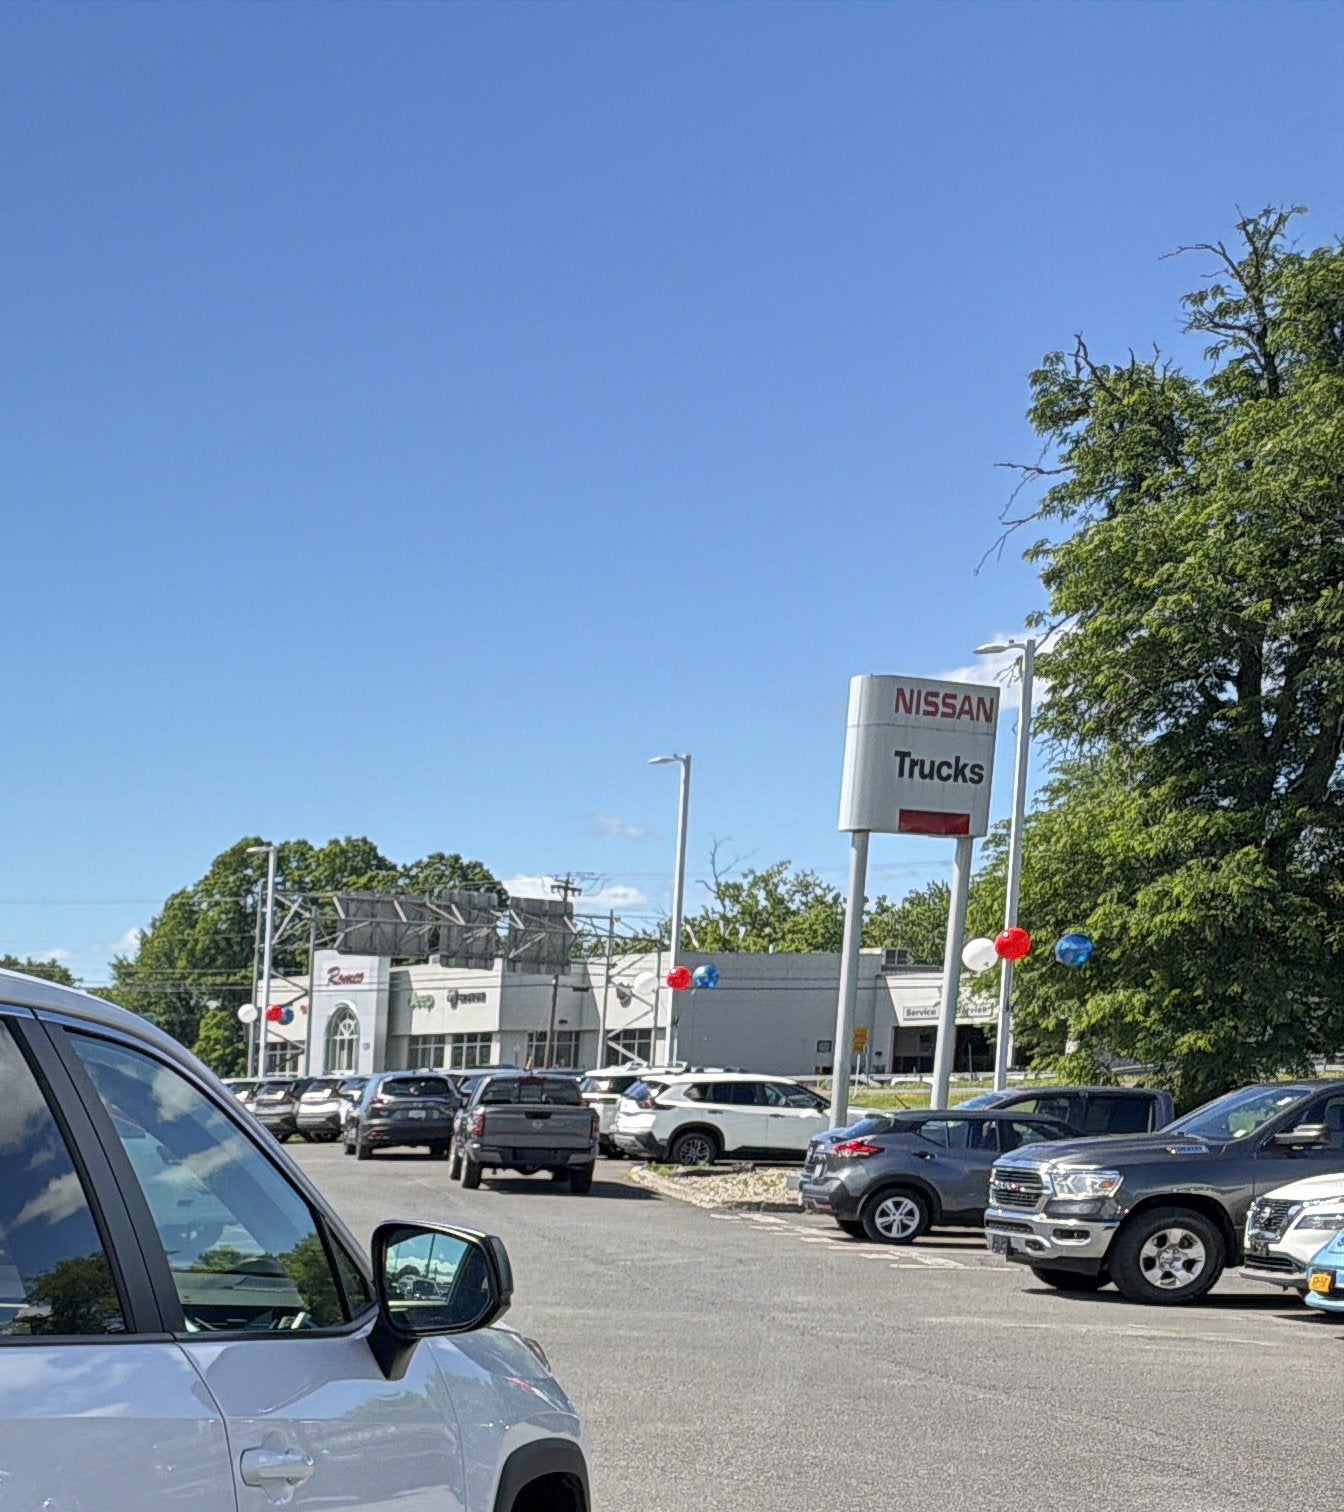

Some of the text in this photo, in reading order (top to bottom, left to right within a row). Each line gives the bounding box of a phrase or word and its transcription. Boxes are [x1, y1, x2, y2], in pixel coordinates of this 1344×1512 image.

[894, 687, 995, 723] NISSAN
[894, 750, 985, 785] Trucks
[326, 966, 364, 986] Romeo
